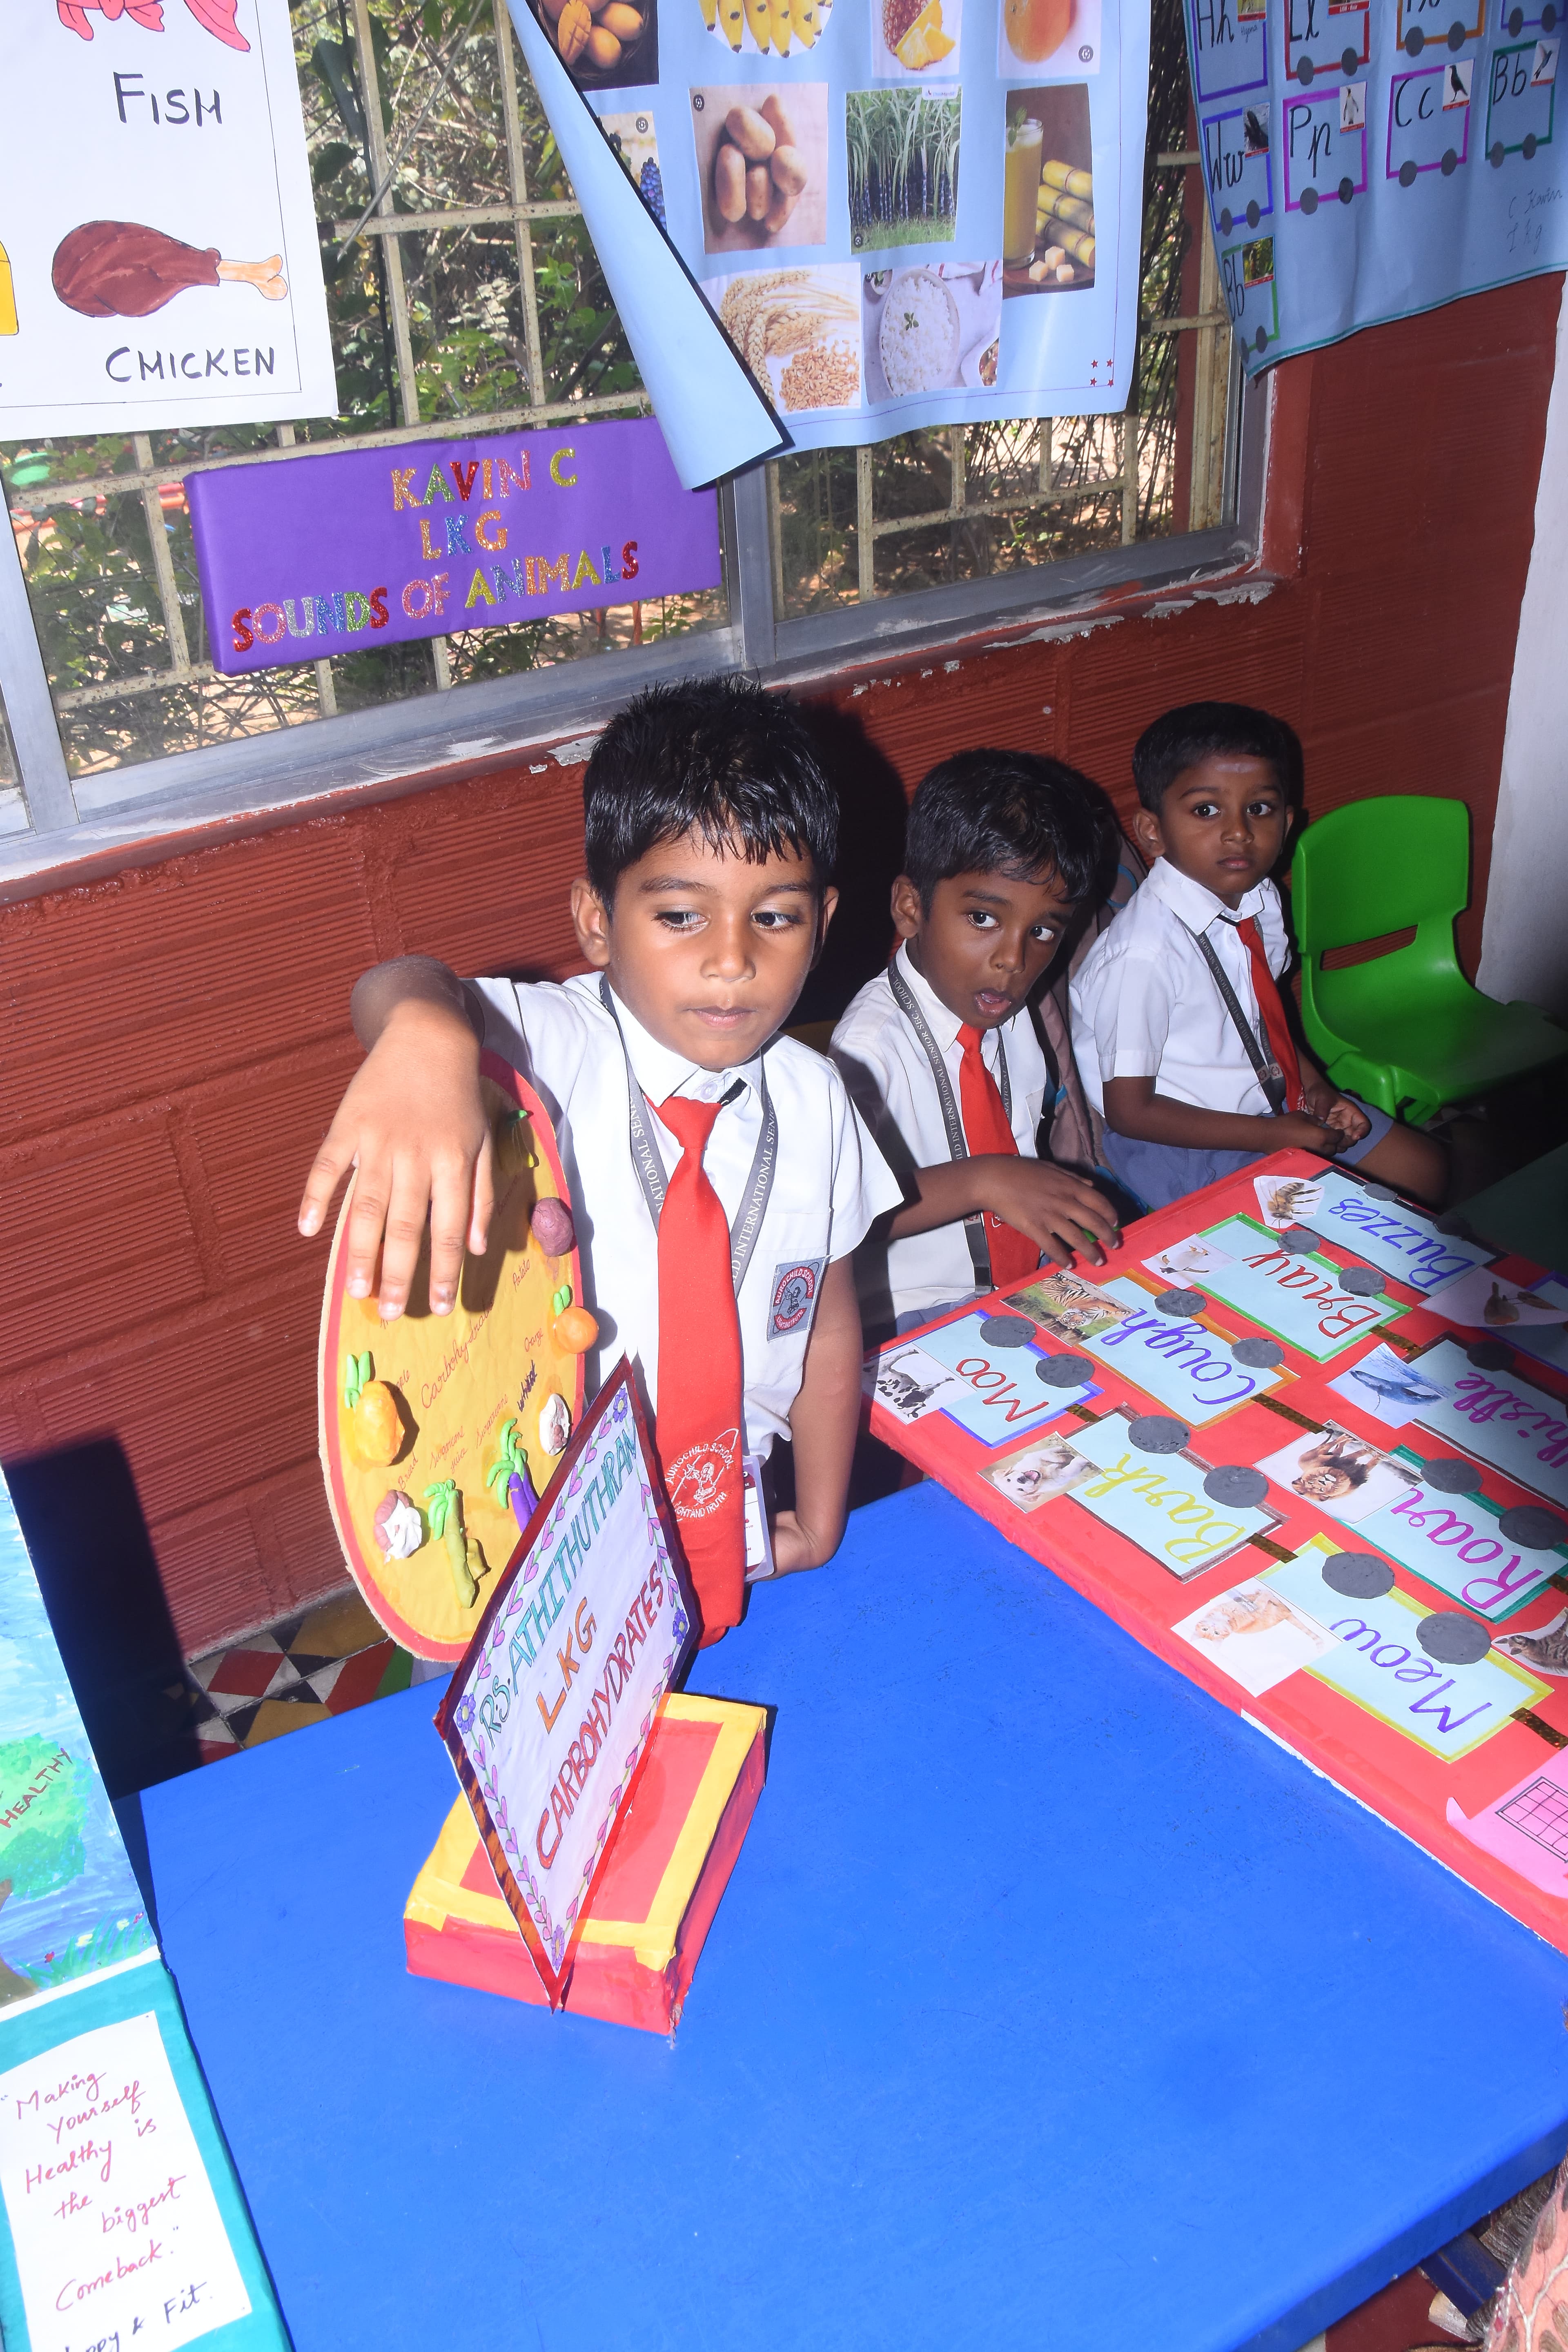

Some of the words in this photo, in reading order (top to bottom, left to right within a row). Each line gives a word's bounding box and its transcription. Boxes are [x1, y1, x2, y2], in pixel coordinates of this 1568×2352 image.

[113, 71, 223, 127] FISH
[390, 450, 532, 511] KAVIN
[550, 448, 577, 488] C
[420, 510, 508, 561] LKG
[232, 586, 390, 653] SOUNDS
[402, 573, 451, 619] OF
[464, 541, 639, 608] ANIMALS
[893, 976, 915, 1010] SCHOOL
[921, 1031, 940, 1065] SENIOR
[937, 1066, 960, 1142] INTERNATIONAL
[734, 1147, 773, 1258] INTERNATIONAL
[1328, 1197, 1476, 1289] Buzzes
[512, 1259, 530, 1293] Potato
[1242, 1249, 1382, 1339] Bray
[1100, 1307, 1256, 1405] Cough
[1083, 1453, 1246, 1565] Bark
[1391, 1487, 1545, 1610] Roar
[536, 1596, 597, 1735] LKG
[1328, 1618, 1493, 1733] Meow
[536, 1561, 664, 1870] CARBOHYDRATES
[26, 2140, 112, 2194] Healthy
[134, 2118, 156, 2137] is
[53, 2192, 93, 2219] the
[102, 2175, 187, 2233] biggest
